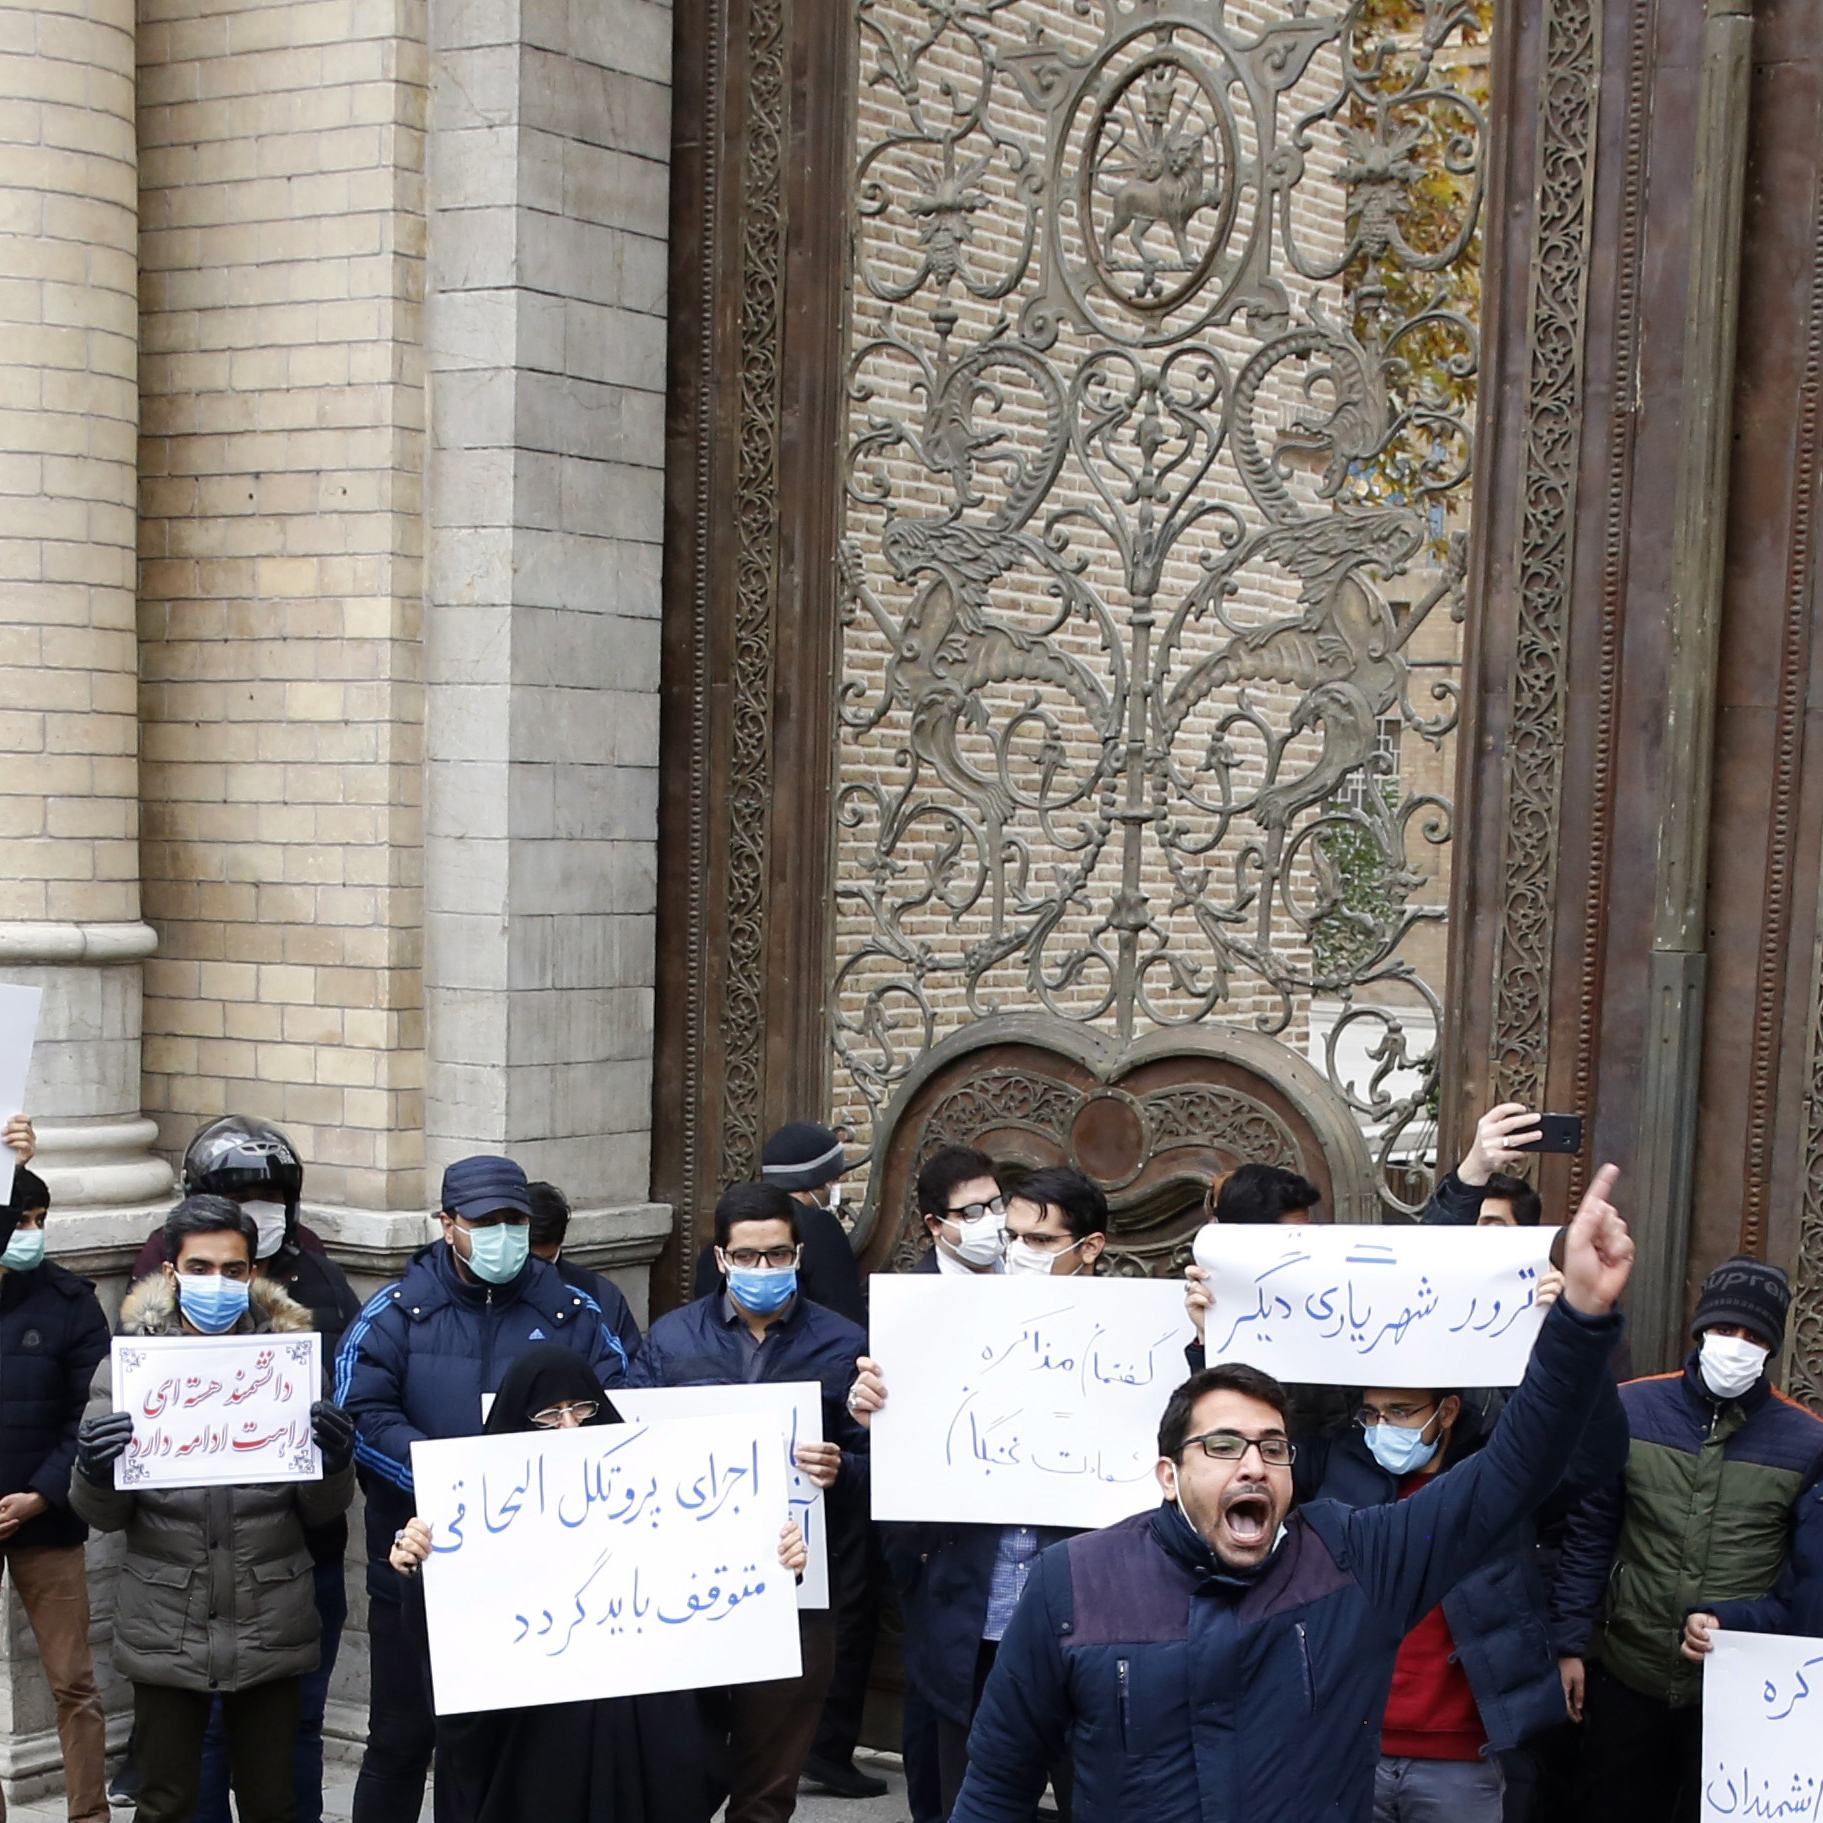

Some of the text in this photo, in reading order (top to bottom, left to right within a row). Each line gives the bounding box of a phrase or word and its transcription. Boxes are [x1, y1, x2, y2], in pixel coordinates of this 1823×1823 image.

[1217, 1250, 1312, 1354] دیگر
[1448, 1266, 1536, 1338] ترور
[1705, 1272, 1788, 1305] upre
[223, 1350, 293, 1405] دانشمند
[980, 1305, 1076, 1375] مذاکره
[130, 1421, 309, 1458] راهت ادامه دارد
[558, 1426, 660, 1529] پروتکل
[431, 1453, 545, 1554] الحاقی
[676, 1439, 758, 1521] اجرای
[513, 1547, 766, 1657] متوقف باید گردد
